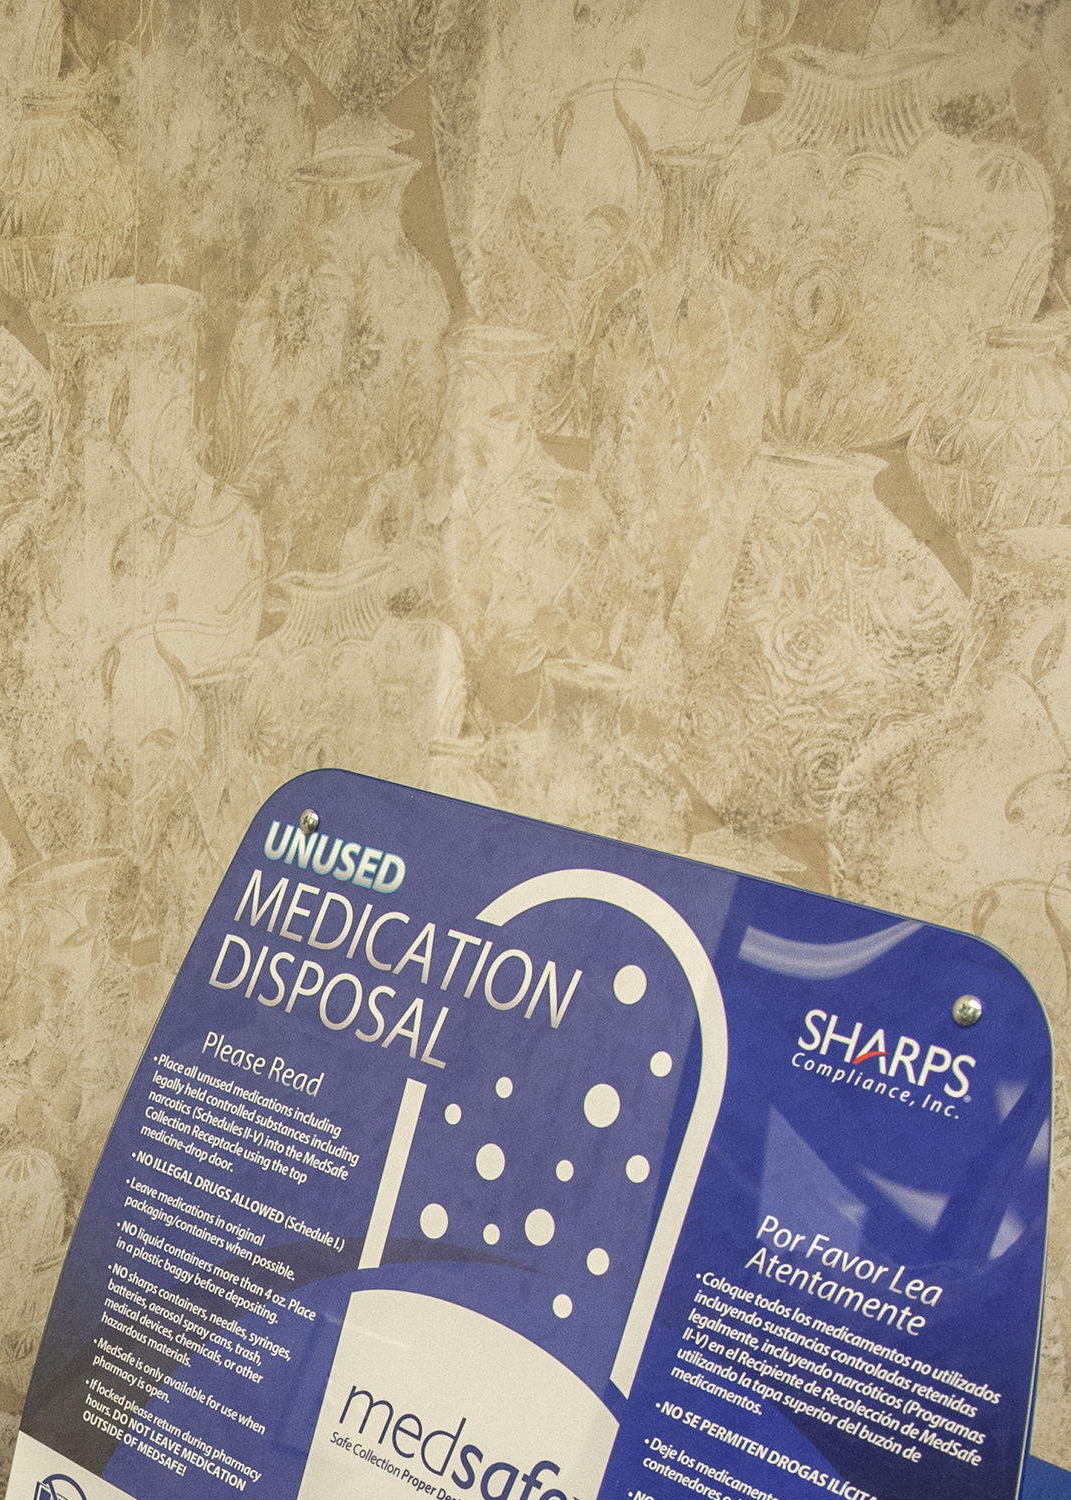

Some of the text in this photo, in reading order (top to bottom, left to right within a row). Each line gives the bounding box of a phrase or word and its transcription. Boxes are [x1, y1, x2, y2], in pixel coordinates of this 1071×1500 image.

[264, 820, 406, 894] UNUSED
[233, 868, 583, 1029] MEDICATION
[208, 933, 450, 1070] DISPOSAL
[157, 1053, 342, 1140] Place all unused medications including
[201, 1031, 325, 1097] Please Read
[790, 1051, 960, 1120] Compliance, Inc.
[797, 1008, 977, 1099] SHARPS
[145, 1106, 308, 1185] Collection Receptacle using the top
[148, 1091, 349, 1181] narcotics (Schedules II-V) into the MedSafe
[152, 1070, 360, 1167] legally held controlled substances including
[124, 1196, 295, 1281] packaging/containers when possible.
[130, 1176, 266, 1246] Leave medications in original
[136, 1150, 345, 1253] NO ILLEGAL DRUGS ALLOWED (Schedule I.)
[744, 1247, 926, 1336] Atentamente
[756, 1214, 944, 1307] Por Favor Lea
[101, 1311, 191, 1368] hazardous materials.
[107, 1278, 262, 1367] batteries, aerosol spray cans, trash,
[111, 1262, 291, 1362] NO sharps containers, needles, syringes,
[694, 1292, 978, 1418] incluyendo sustancias controladas retenidas
[702, 1272, 1002, 1404] Coloque todos los medicamentos no utilizados
[670, 1366, 762, 1416] medicamentos.
[688, 1307, 986, 1445] legalmente, incluyendo narcóticos (Programas
[82, 1410, 187, 1477] OUTSIDE OF MEDSAFE!
[85, 1393, 247, 1491] hours. DO NOT LEAVE MEDICATION
[329, 1431, 353, 1451] Safe
[352, 1443, 401, 1478] Collection
[400, 1468, 437, 1497] Proper
[649, 1437, 678, 1460] Deje
[676, 1449, 696, 1468] los
[660, 1401, 684, 1420] NO
[682, 1411, 702, 1429] SE
[699, 1419, 769, 1460] PERMITEN
[766, 1450, 829, 1487] DROGAS
